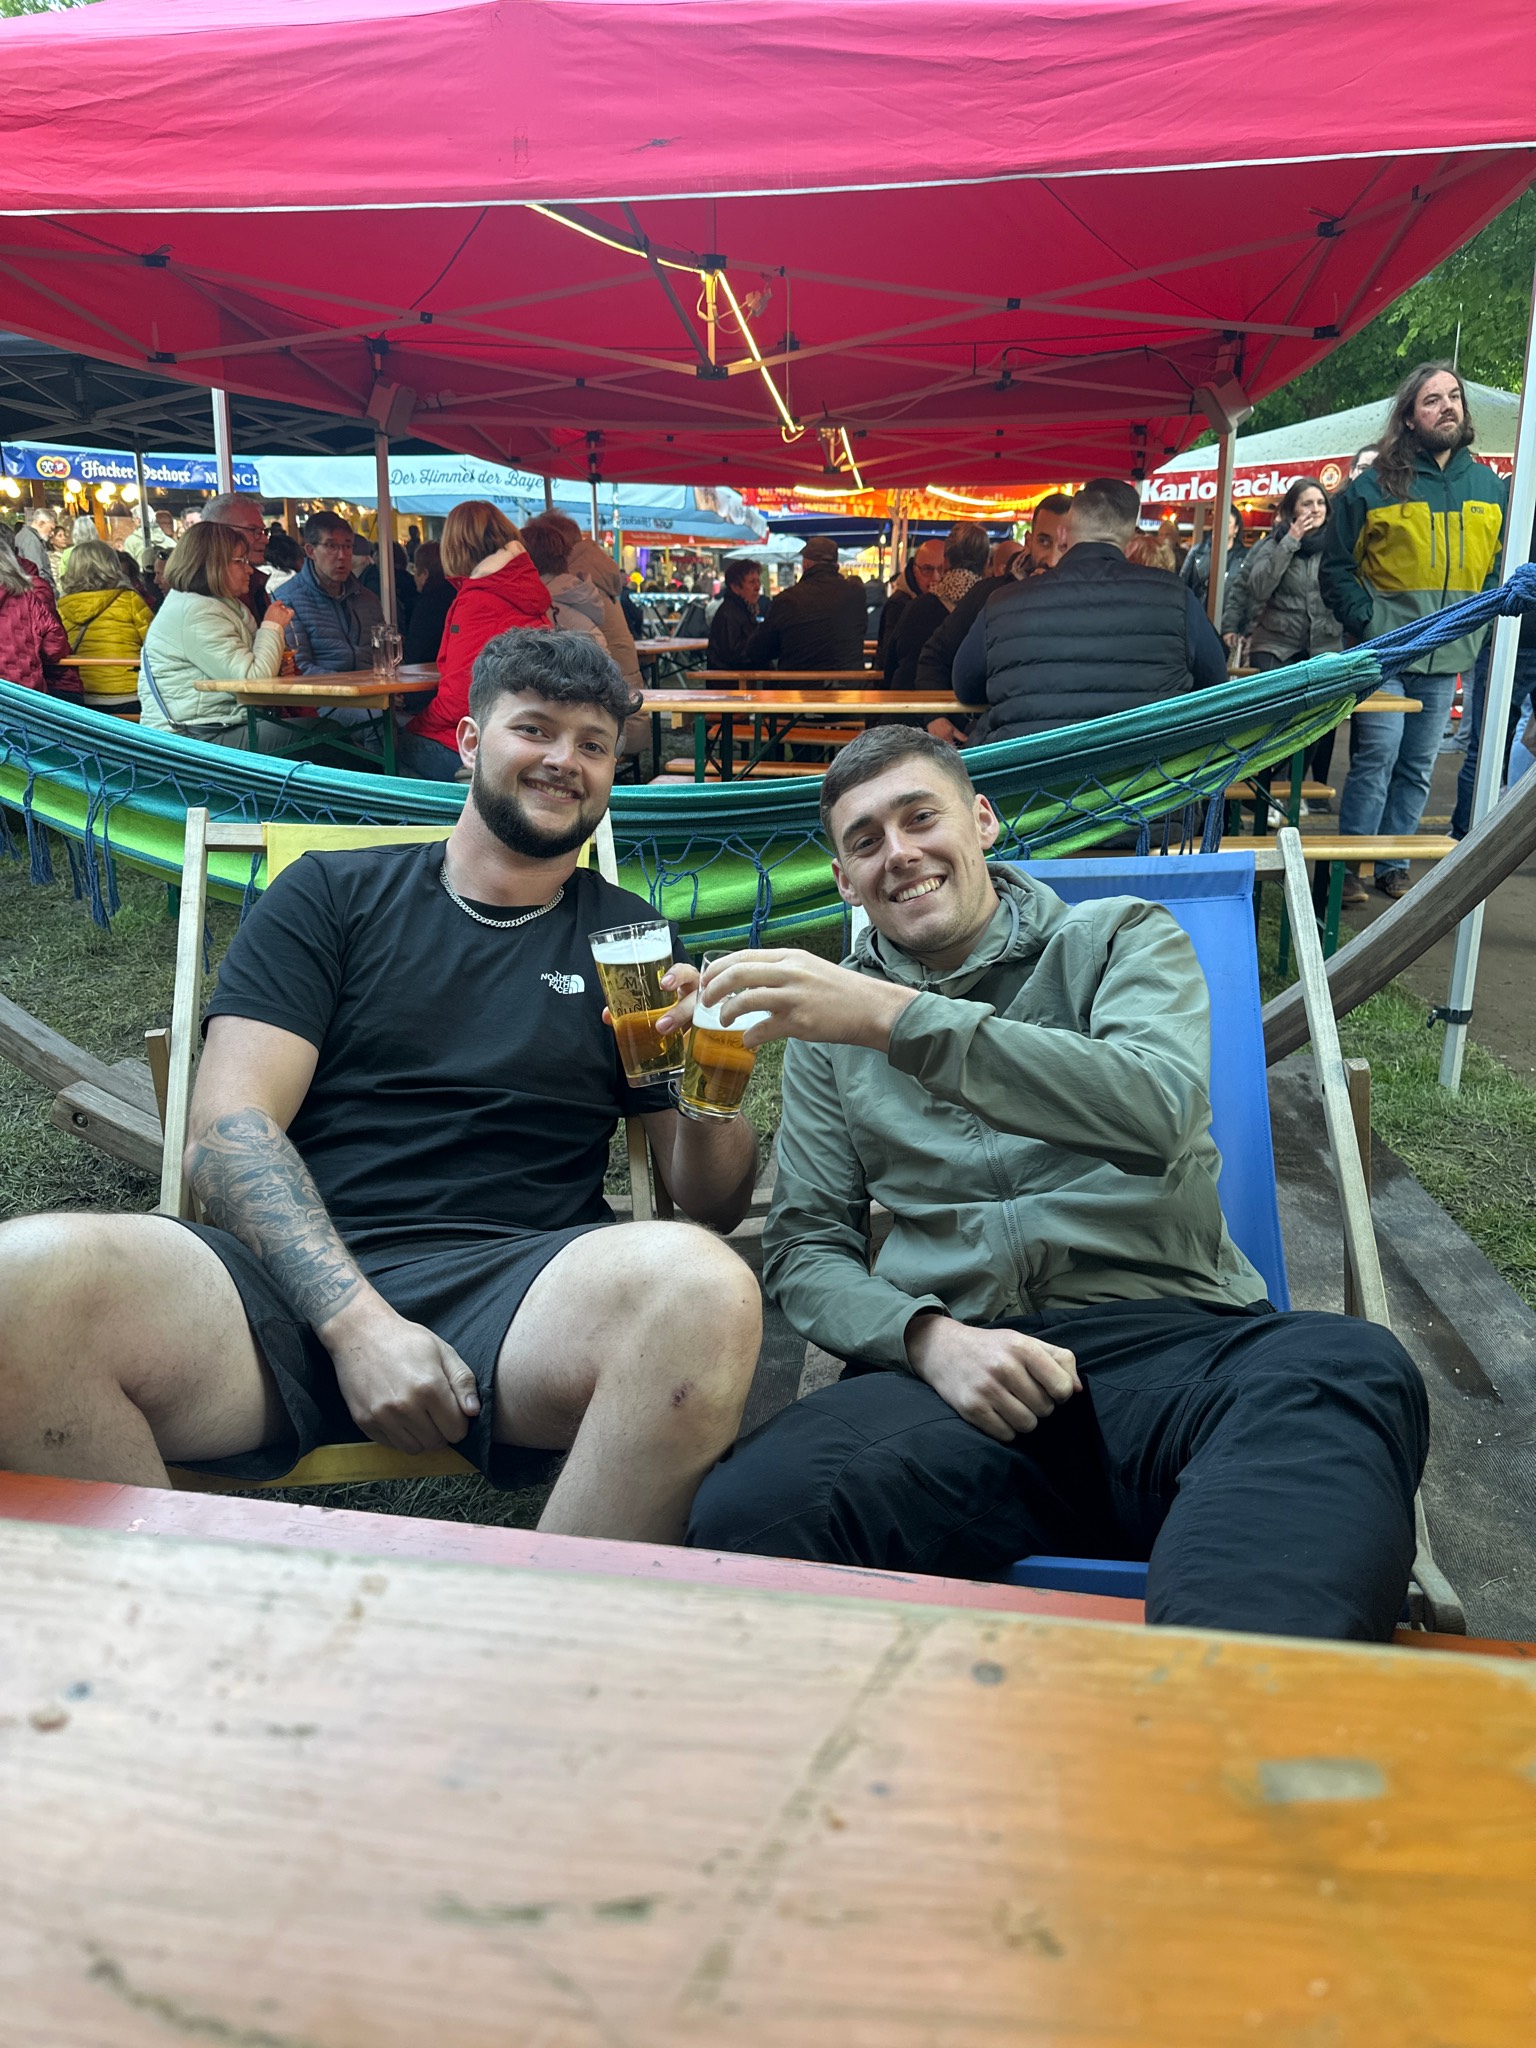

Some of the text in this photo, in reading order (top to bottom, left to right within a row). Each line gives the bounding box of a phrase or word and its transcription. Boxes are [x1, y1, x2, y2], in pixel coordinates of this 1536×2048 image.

[204, 472, 259, 486] MNCH
[389, 468, 560, 492] Der Himmel der Bayen
[1141, 470, 1304, 502] Karloačk
[540, 973, 570, 988] NORTH
[555, 970, 571, 981] THE
[549, 979, 569, 994] FACE
